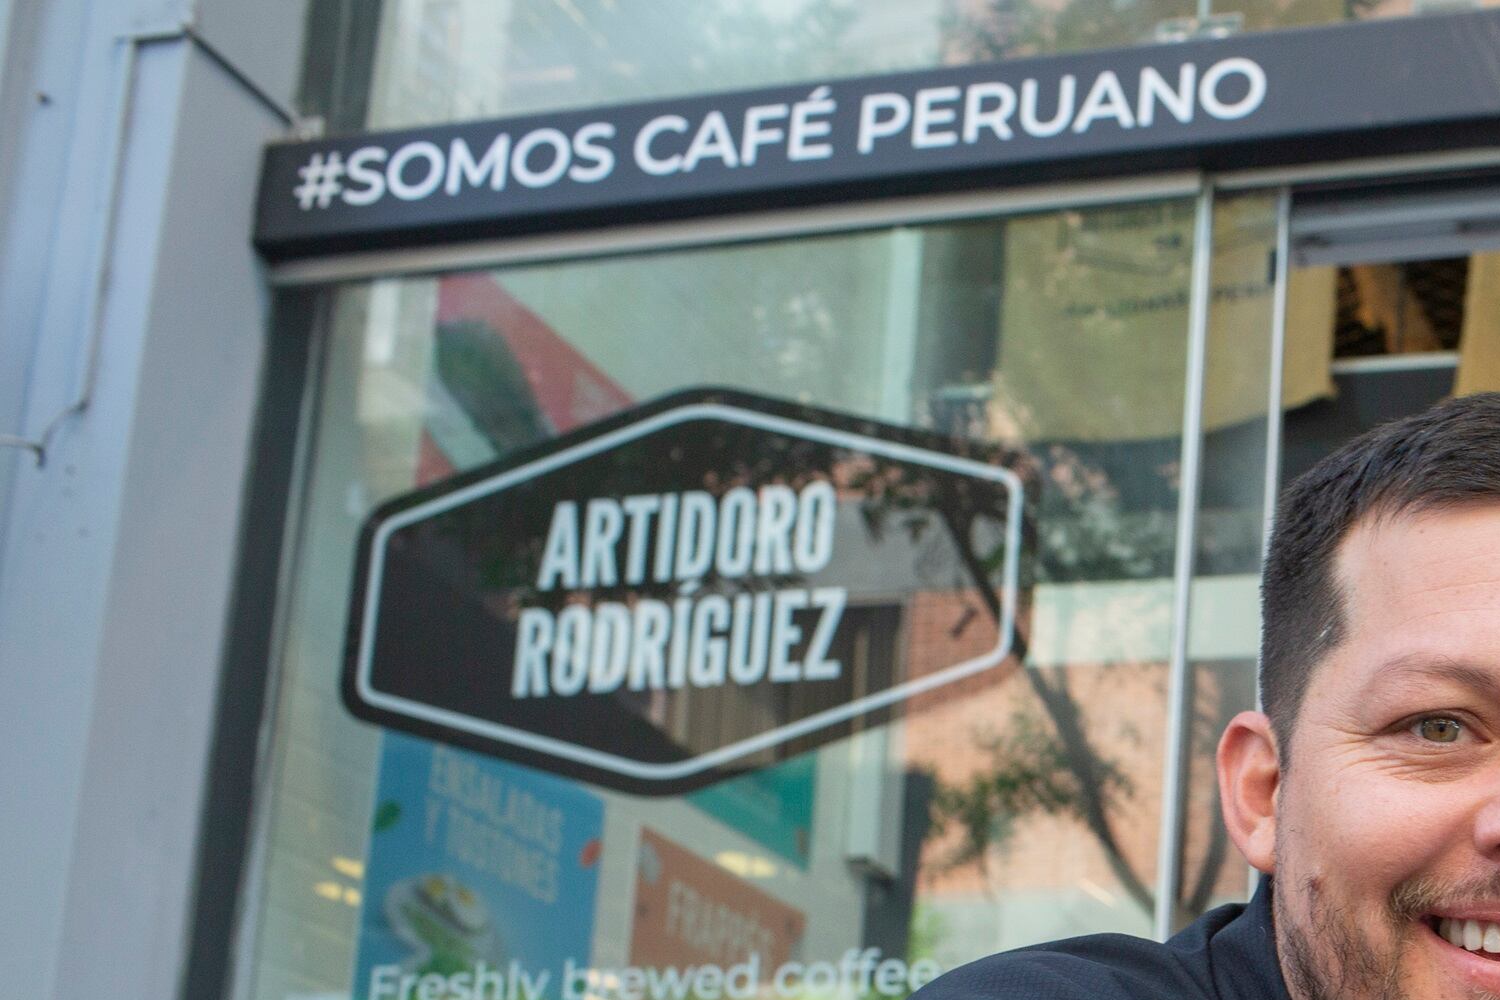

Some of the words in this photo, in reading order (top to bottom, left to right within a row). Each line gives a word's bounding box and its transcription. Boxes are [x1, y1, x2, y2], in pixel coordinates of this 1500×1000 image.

[294, 123, 615, 210] #SOMOS
[633, 85, 836, 177] CAFÉ
[857, 57, 1268, 154] PERUANO
[537, 481, 838, 592] ARTIDORO
[511, 578, 848, 700] RODRÍGUEZ
[773, 946, 942, 998] coffee
